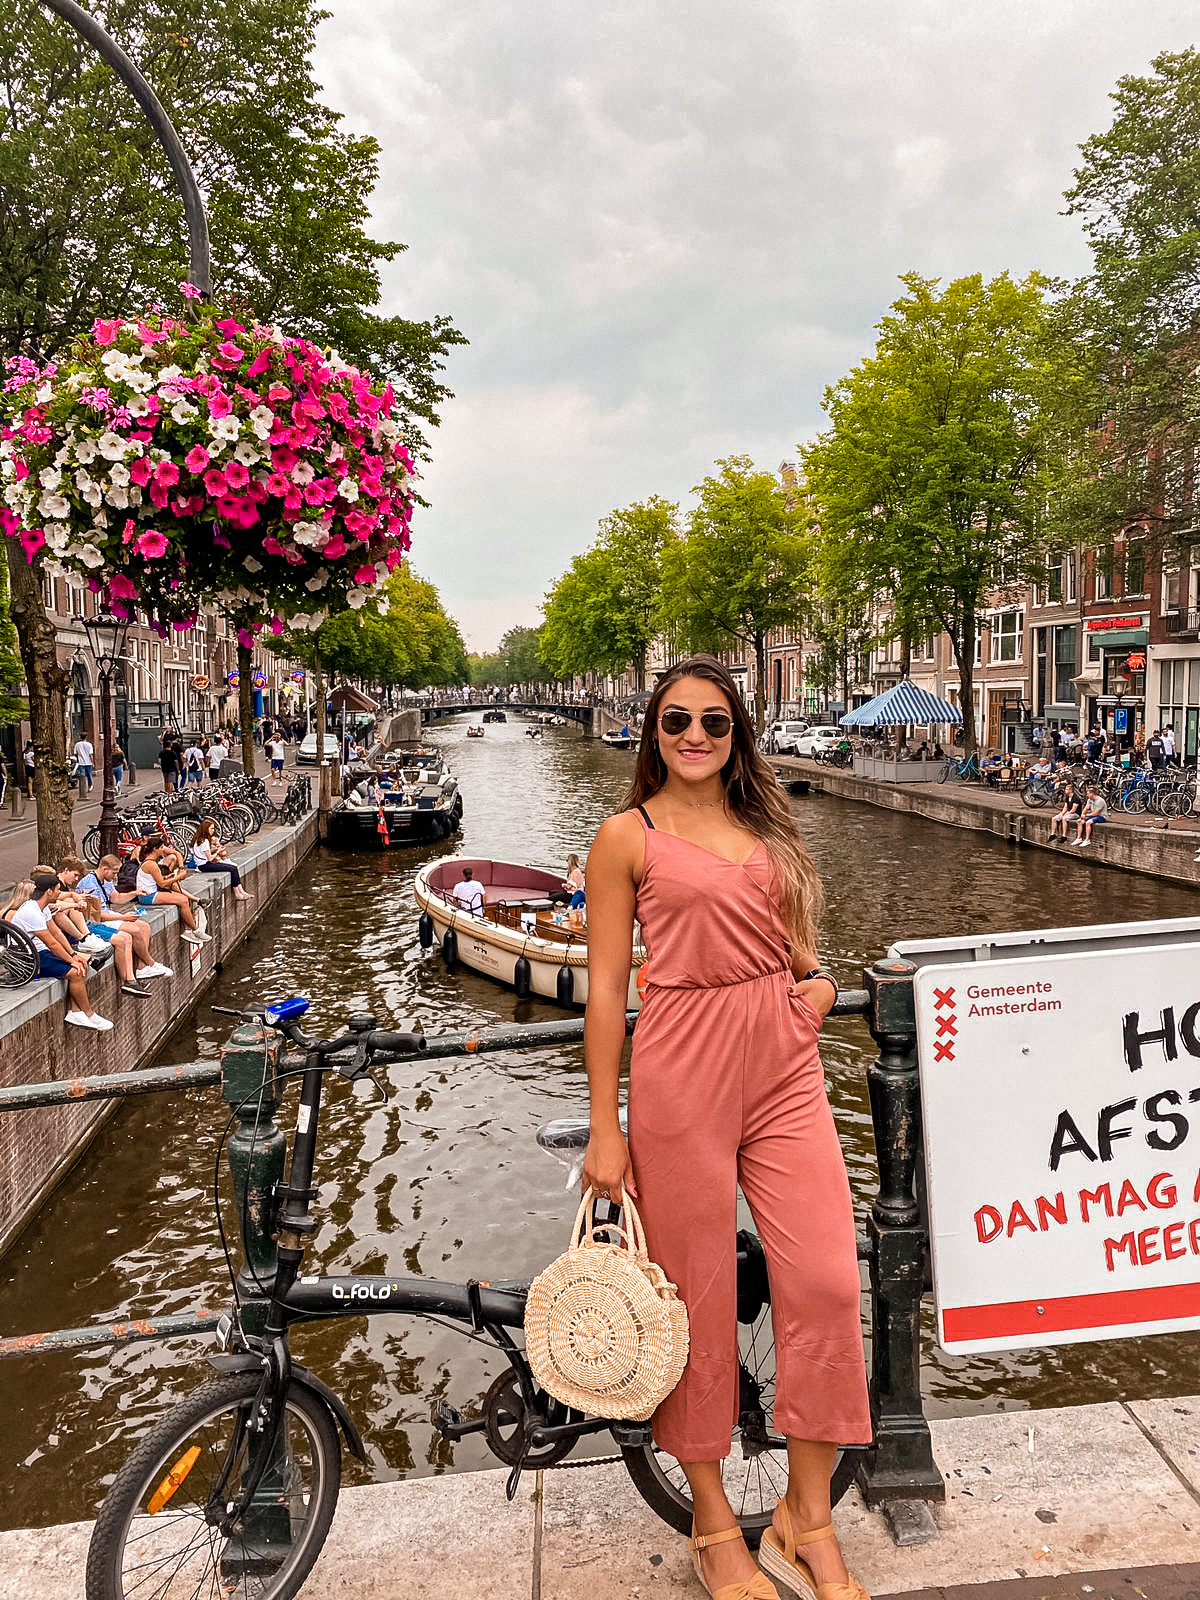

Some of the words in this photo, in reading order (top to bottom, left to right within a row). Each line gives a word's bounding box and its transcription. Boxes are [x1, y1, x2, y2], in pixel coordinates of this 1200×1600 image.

[967, 981, 1052, 999] Gemeente
[968, 998, 1062, 1017] Amsterdam
[1048, 1088, 1200, 1172] AFS
[974, 1190, 1068, 1243] DAN
[1078, 1172, 1178, 1223] MAG
